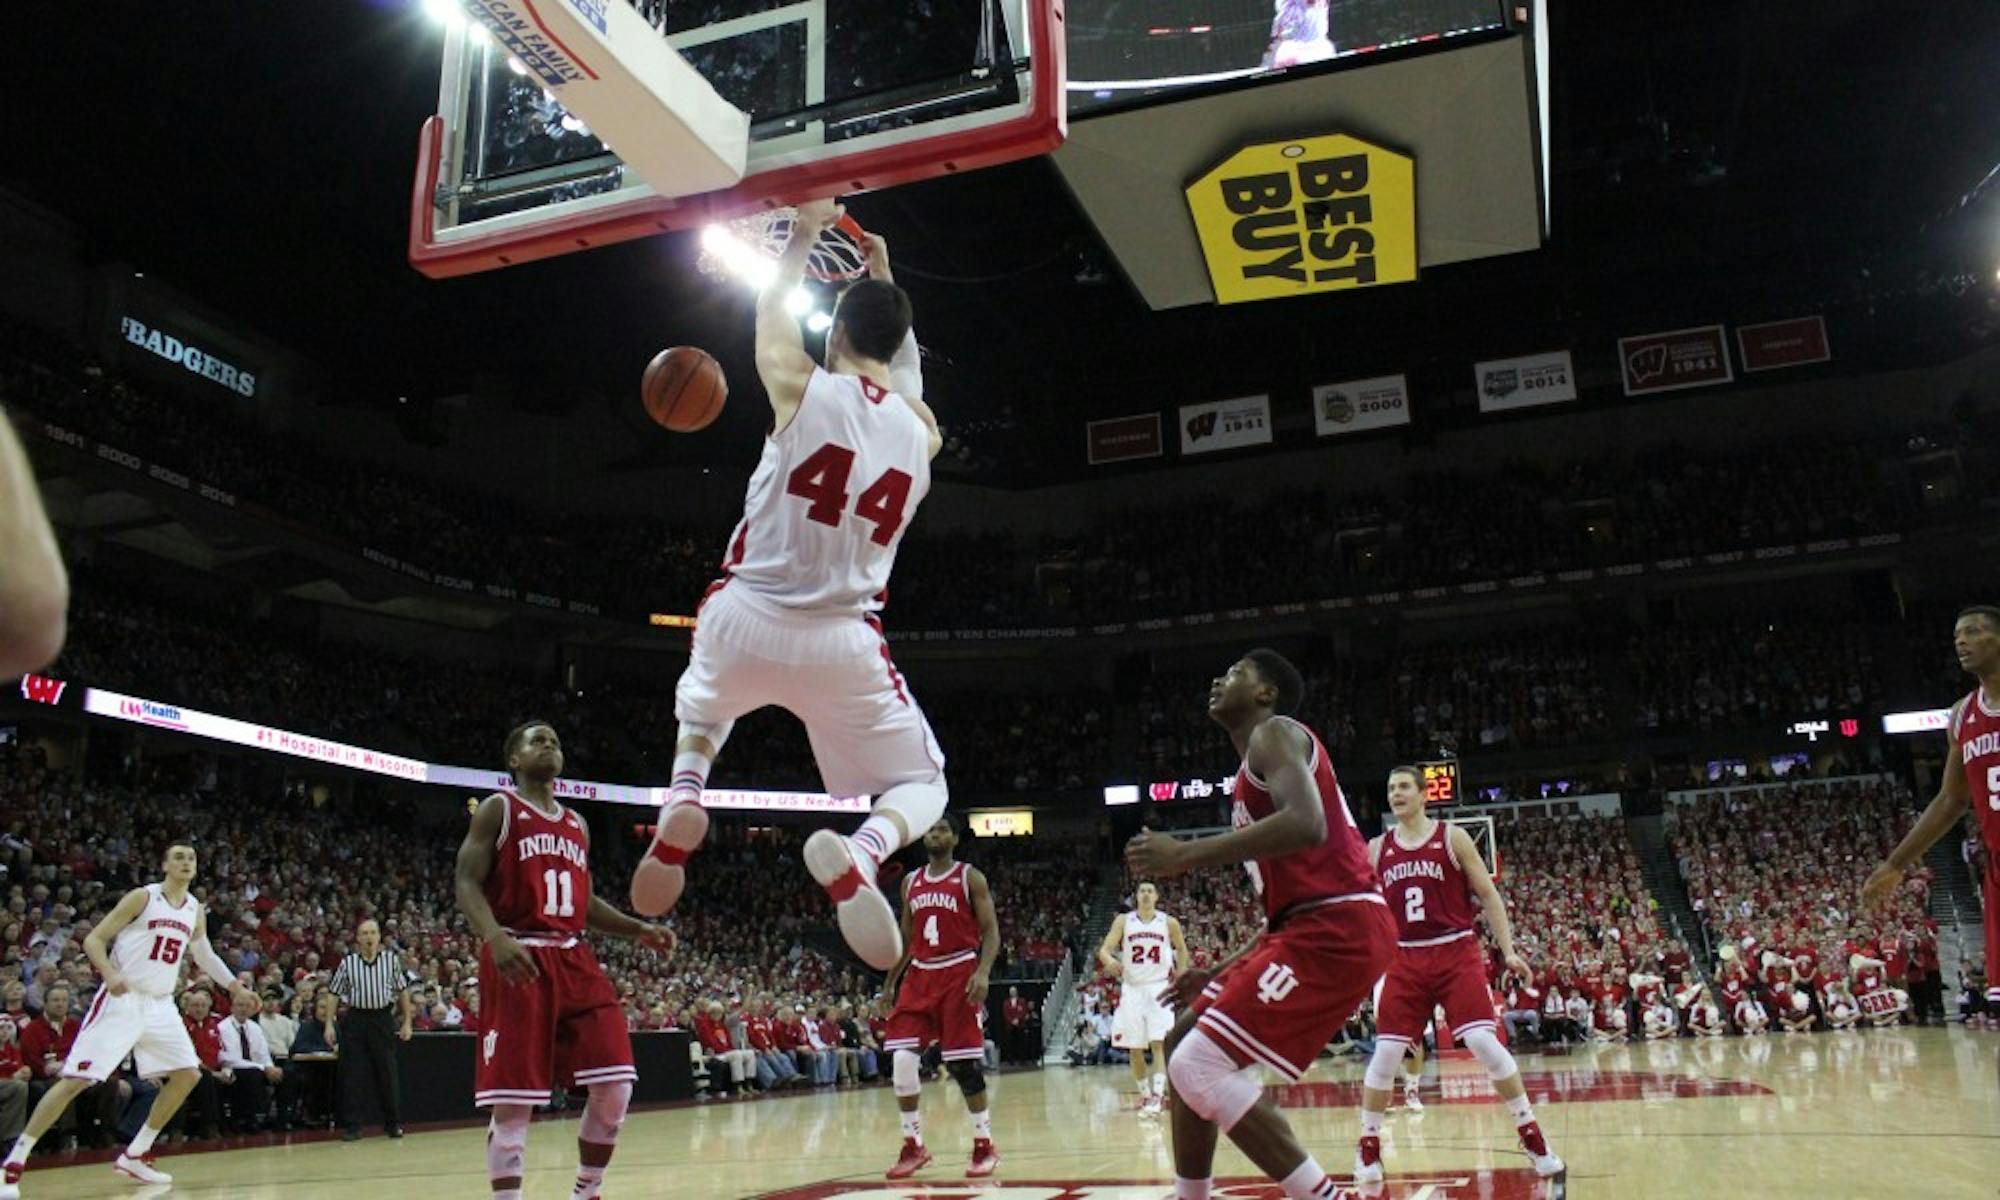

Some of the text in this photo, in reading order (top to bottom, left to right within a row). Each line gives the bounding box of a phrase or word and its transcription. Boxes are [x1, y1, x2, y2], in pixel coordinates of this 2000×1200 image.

[483, 0, 529, 31] CAN
[523, 33, 586, 81] FAMILY
[1219, 170, 1308, 284] BUY
[1297, 152, 1377, 285] BEST
[1673, 357, 1717, 375] 1941
[1523, 374, 1567, 390] 2014
[1360, 398, 1402, 413] 2000
[1224, 418, 1264, 433] 1941
[786, 441, 913, 547] 44
[256, 728, 427, 778] #1 Hospital in Wisconsin
[497, 775, 597, 800] uwth.org
[729, 794, 746, 805] #1
[753, 795, 770, 807] by
[779, 796, 799, 806] US
[805, 796, 845, 808] News
[518, 833, 586, 870] INDIANA
[1383, 860, 1446, 888] INDIANA
[543, 868, 575, 917] 11
[909, 892, 959, 914] INDIANA
[1405, 886, 1426, 923] 2
[922, 914, 940, 947] 4
[148, 935, 183, 965] 15
[1131, 945, 1161, 964] 24
